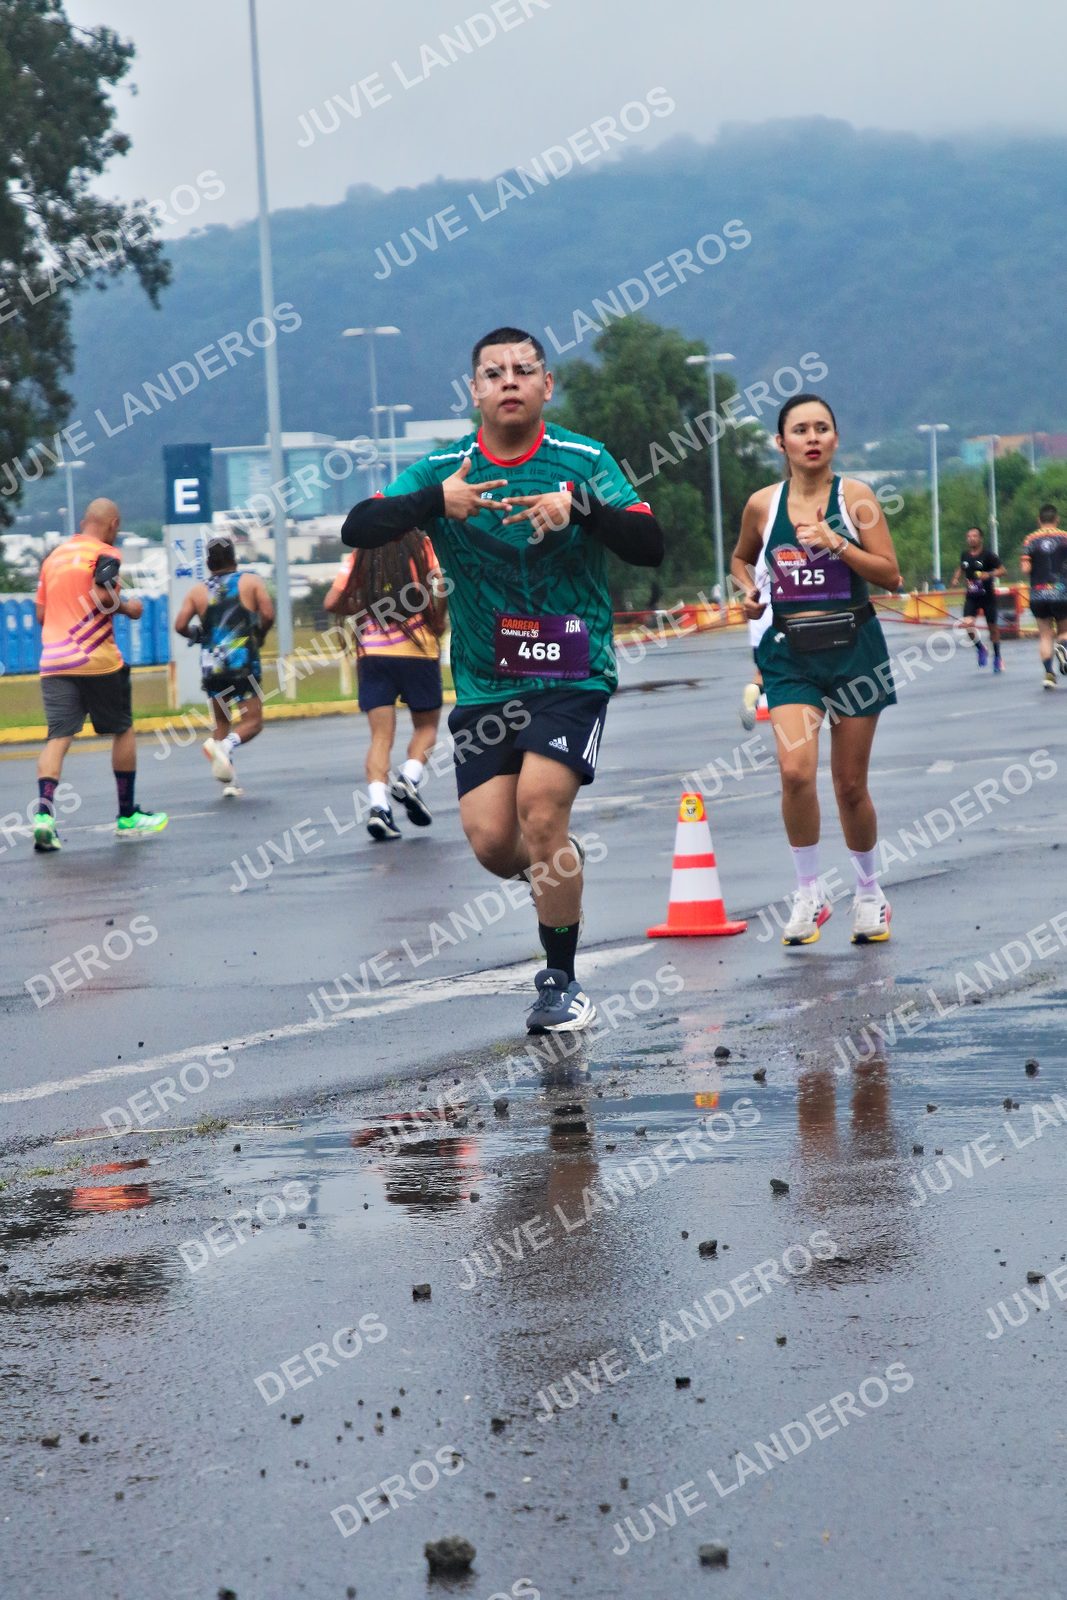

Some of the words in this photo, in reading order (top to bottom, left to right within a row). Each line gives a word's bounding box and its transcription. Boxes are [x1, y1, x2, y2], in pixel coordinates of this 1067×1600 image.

[174, 478, 200, 513] E
[791, 569, 825, 585] 125
[501, 618, 540, 630] CARRERA
[501, 628, 530, 637] OMNILIFE
[518, 641, 560, 661] 468
